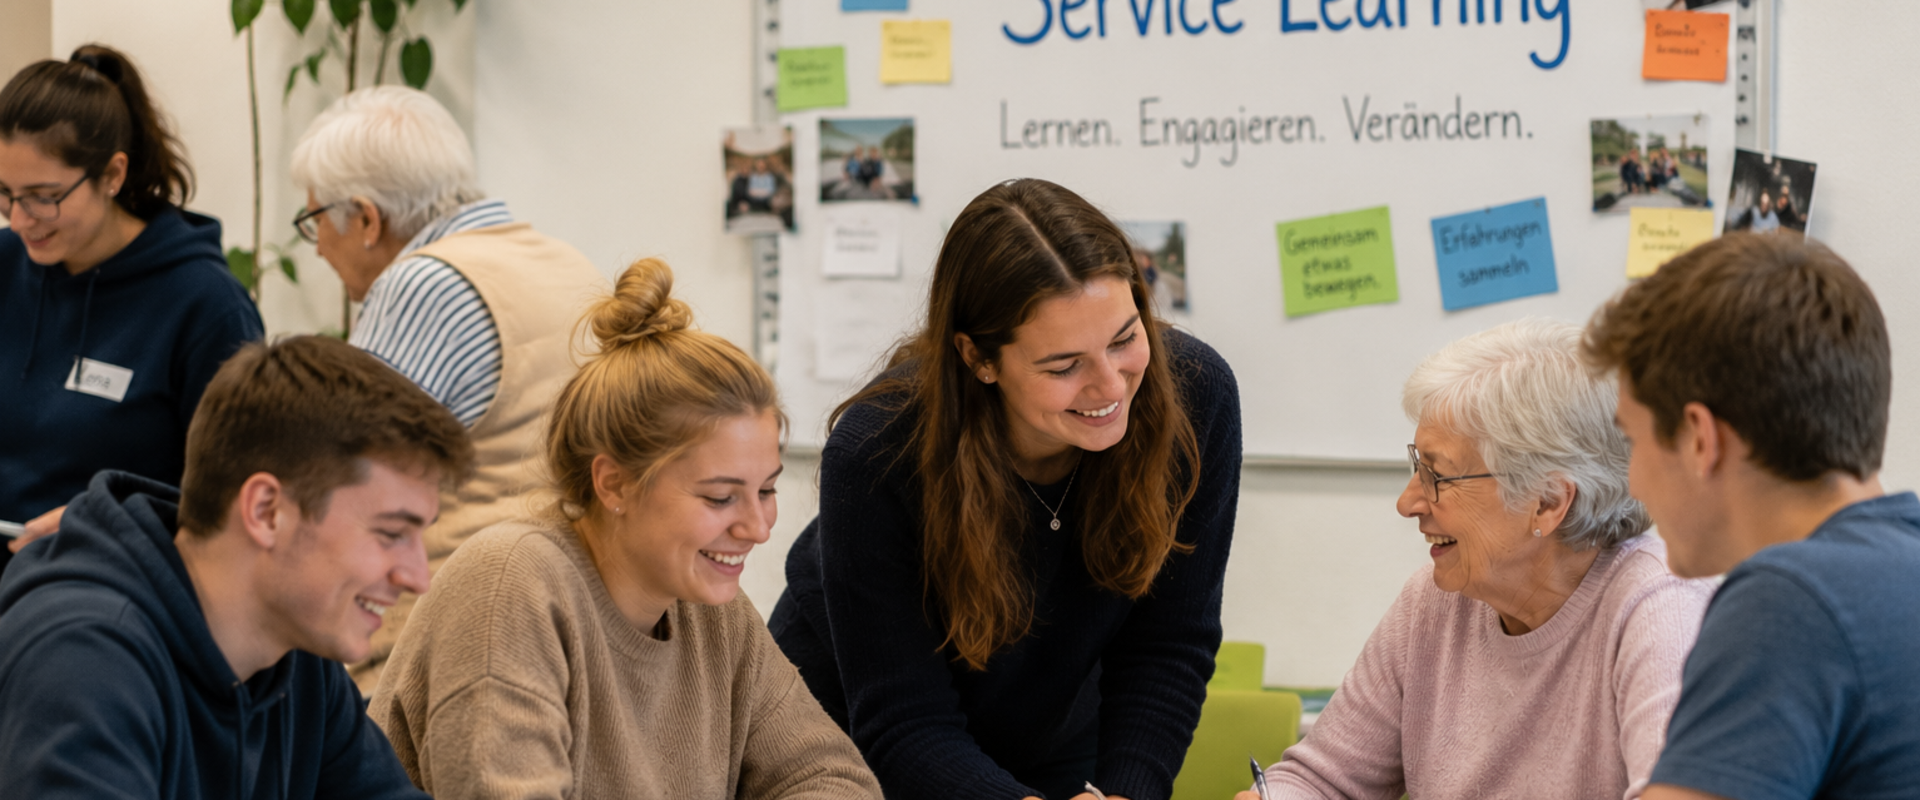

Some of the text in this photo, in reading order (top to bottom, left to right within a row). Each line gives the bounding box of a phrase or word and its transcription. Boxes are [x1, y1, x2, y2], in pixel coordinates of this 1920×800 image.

[1002, 0, 1244, 45] Service
[1000, 94, 1533, 168] Lernen. Engagieren. Verändern.
[1283, 227, 1378, 257] Gemeinsam
[1438, 220, 1541, 255] Erfahrungen
[1303, 257, 1351, 277] etwas
[1303, 274, 1382, 300] bewegen.
